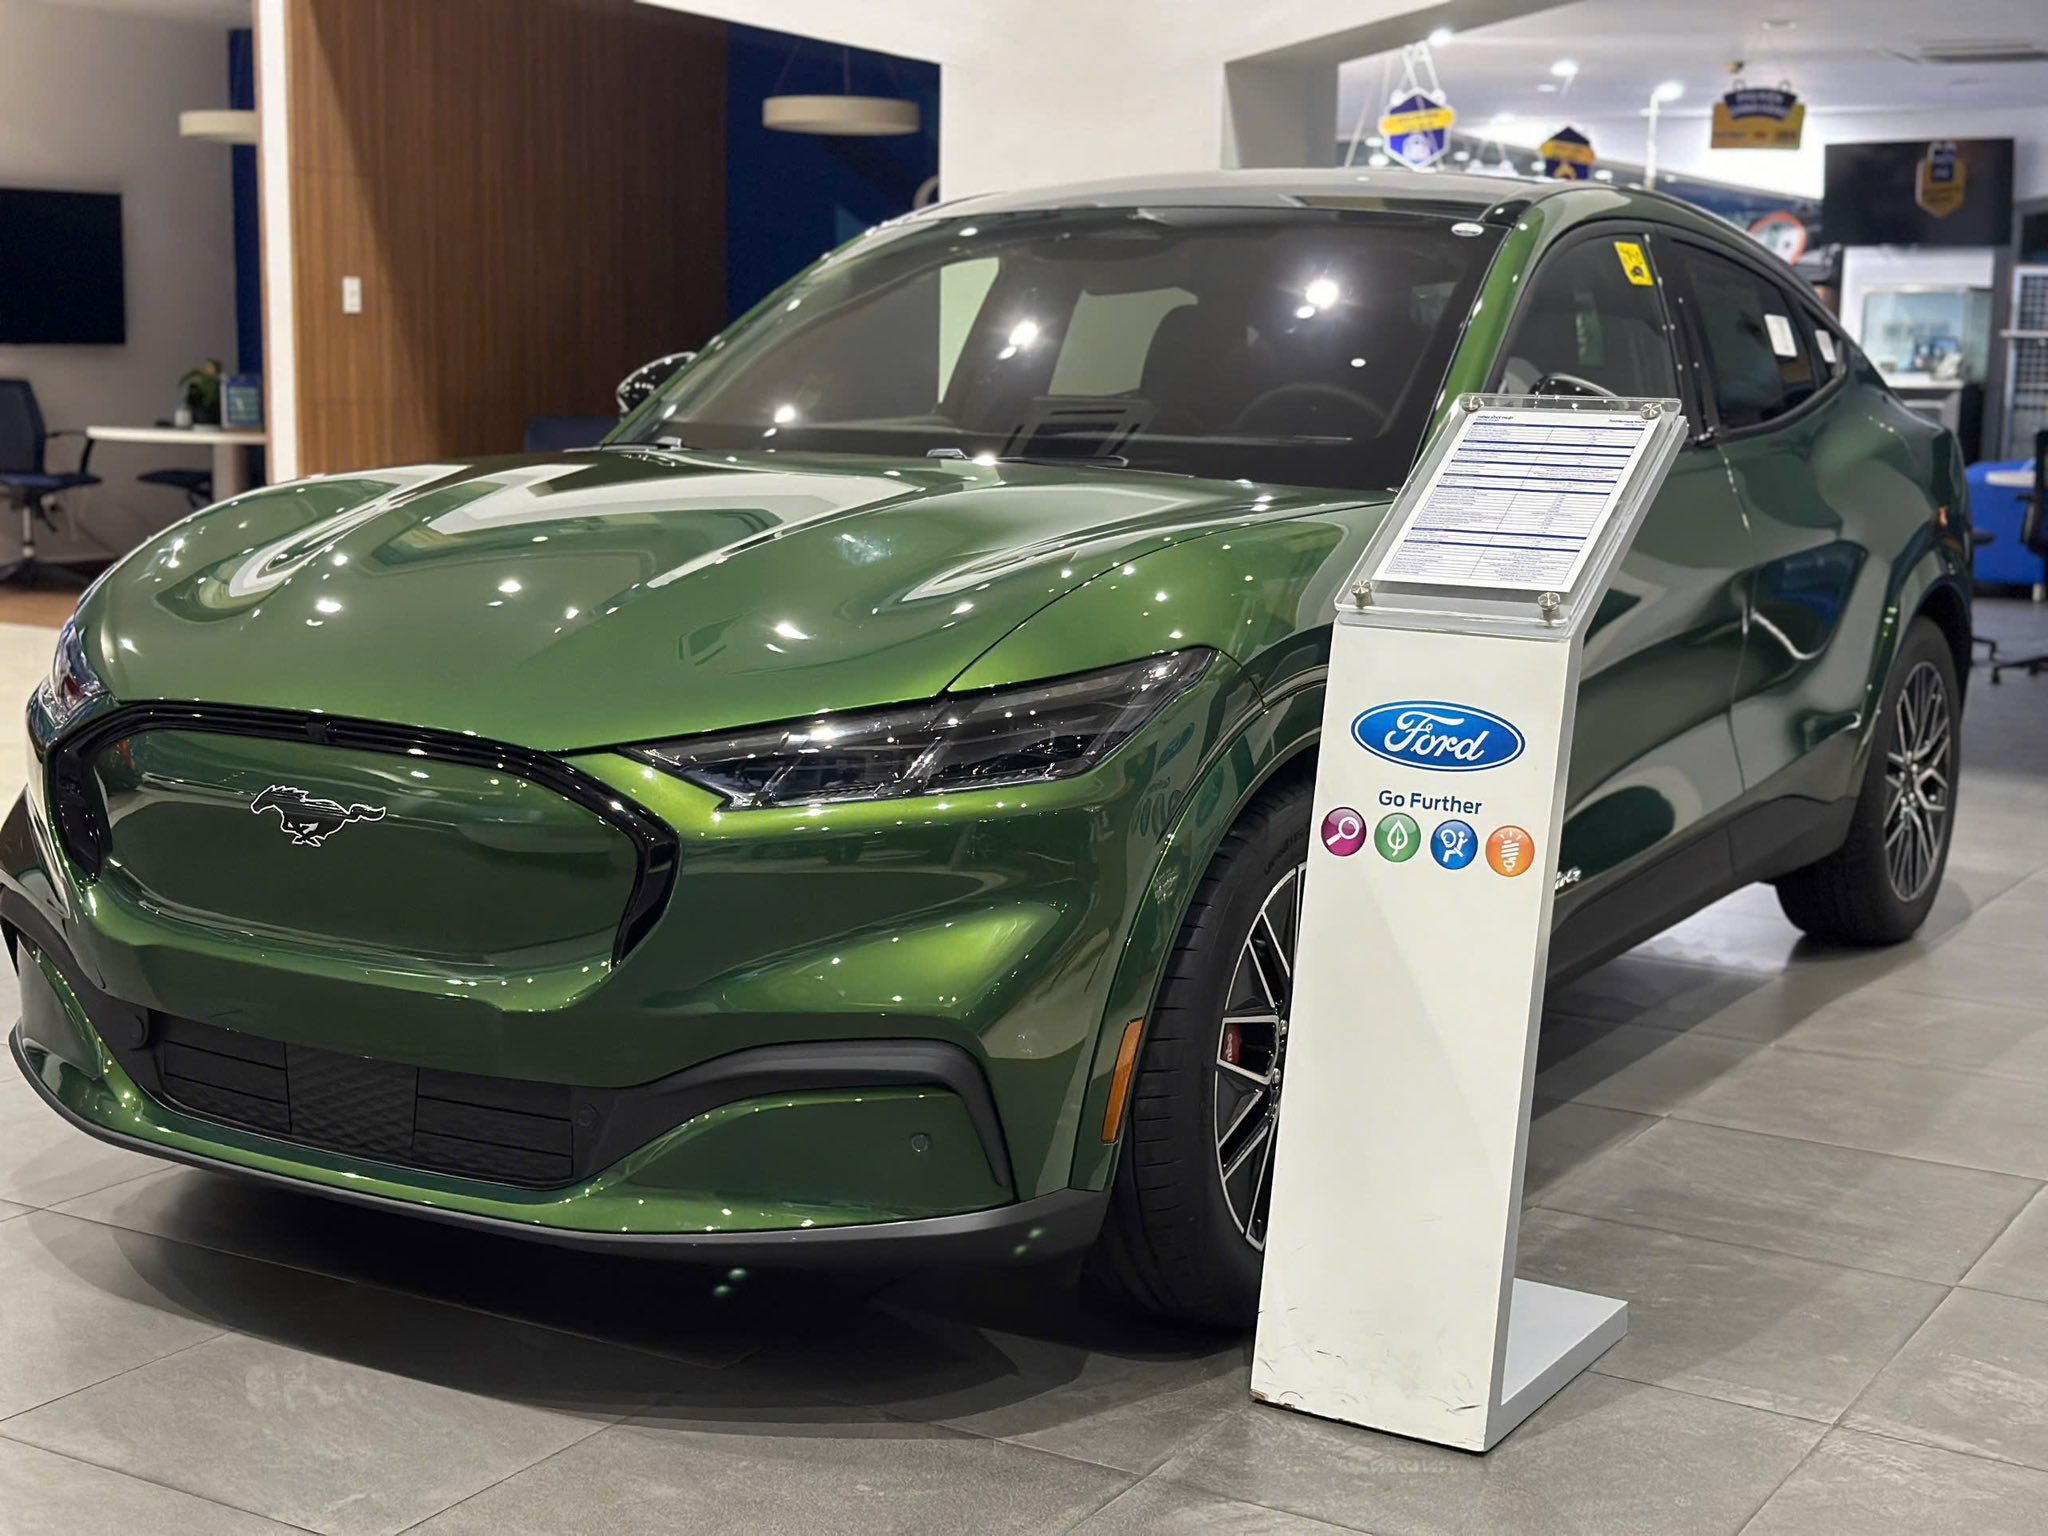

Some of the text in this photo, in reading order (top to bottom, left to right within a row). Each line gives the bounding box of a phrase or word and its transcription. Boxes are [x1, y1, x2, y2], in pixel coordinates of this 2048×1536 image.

[1384, 711, 1490, 761] Ford
[1378, 790, 1483, 815] Go Further
